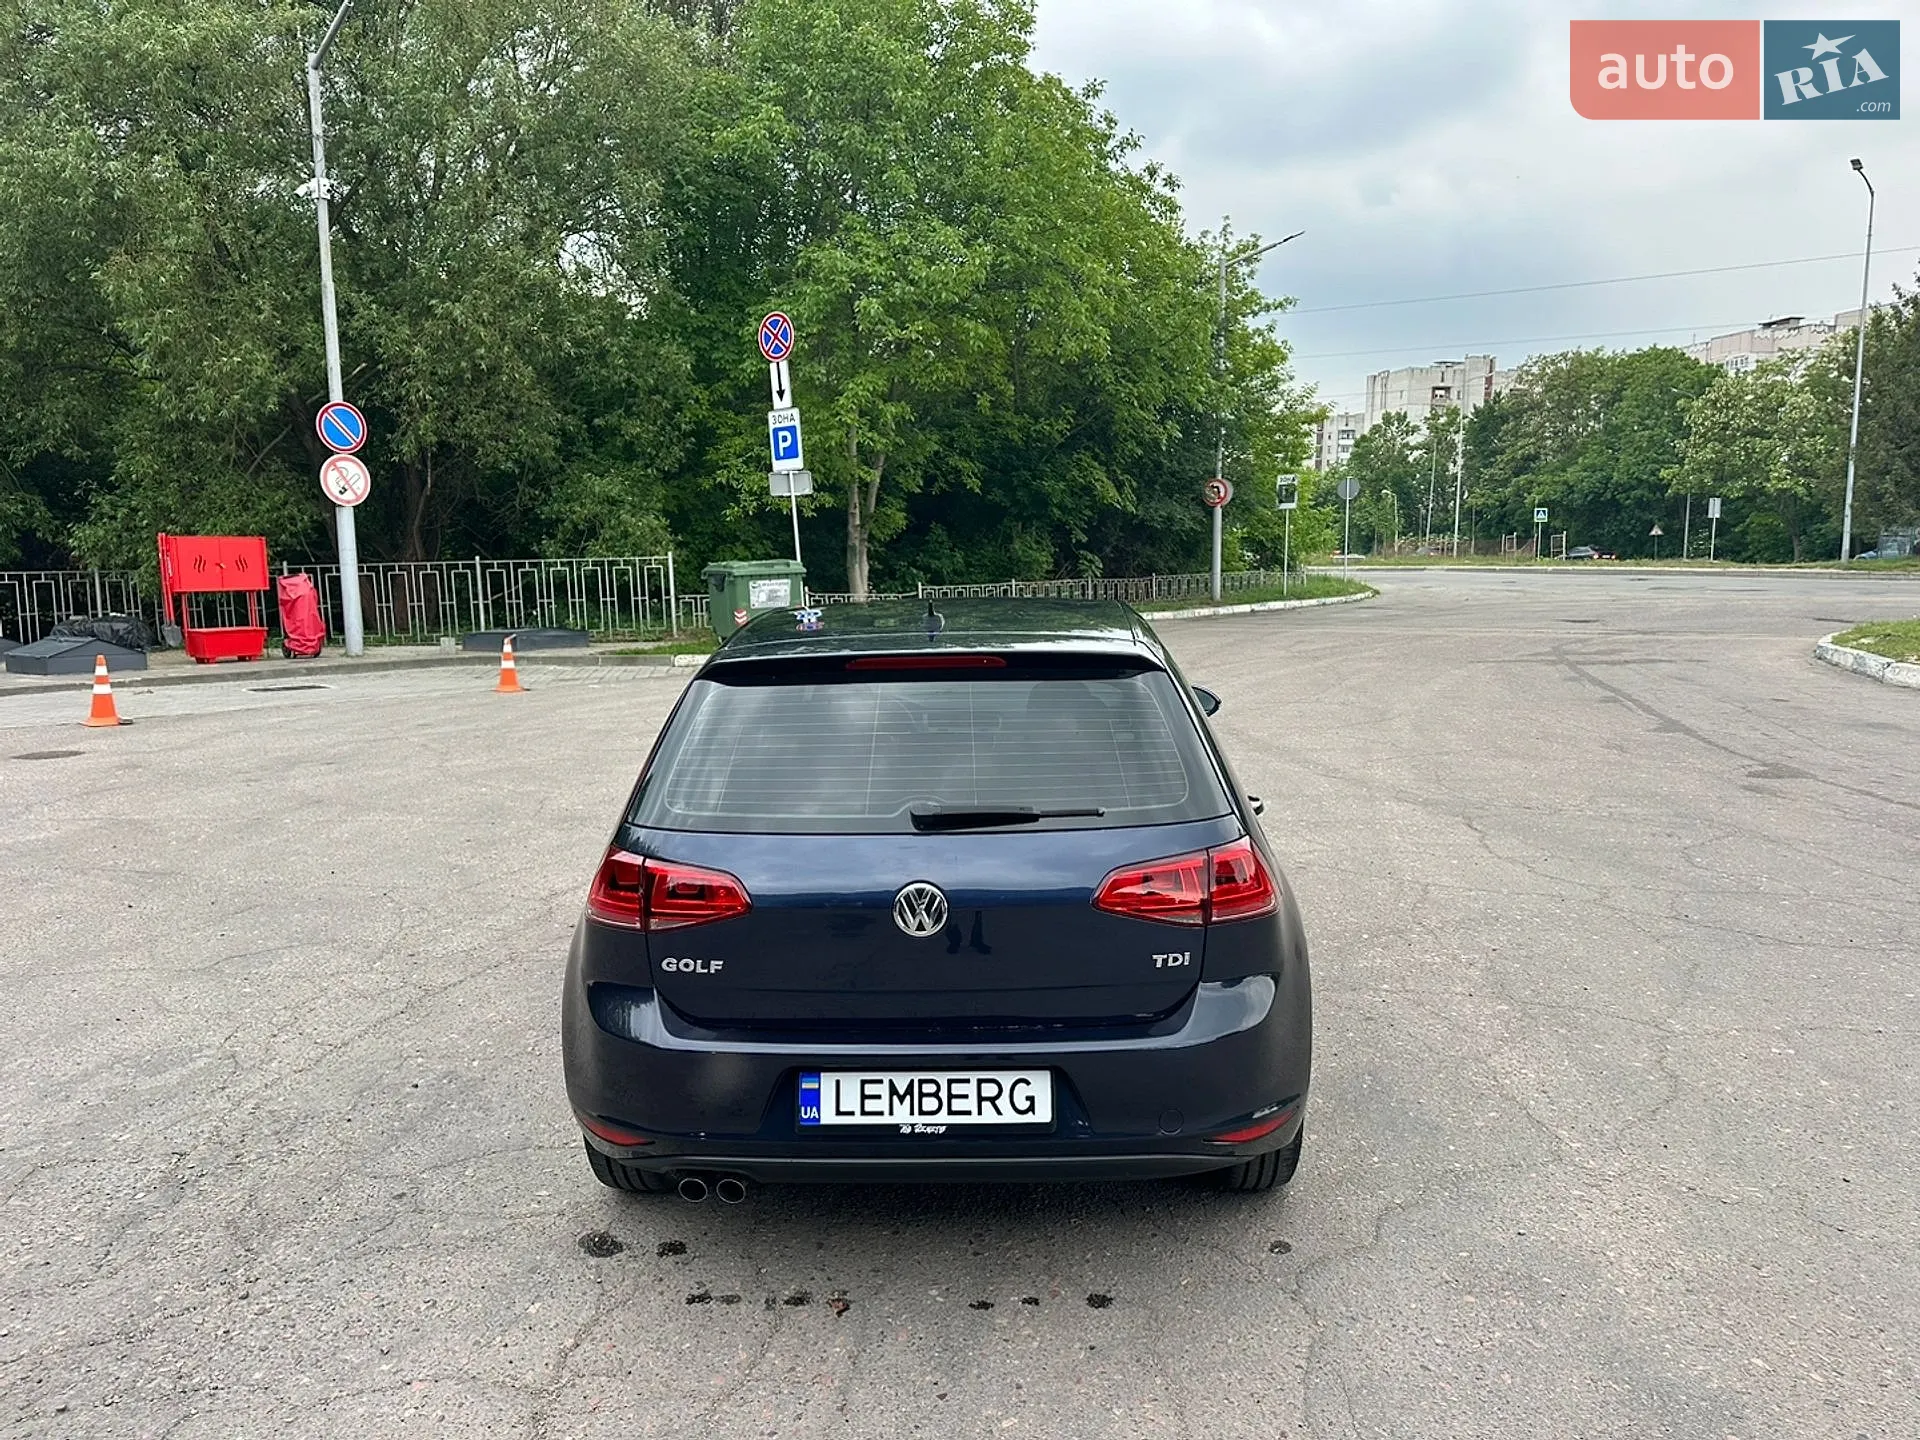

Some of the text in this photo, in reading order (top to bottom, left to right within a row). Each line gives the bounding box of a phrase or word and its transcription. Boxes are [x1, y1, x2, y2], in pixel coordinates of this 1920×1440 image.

[772, 413, 795, 425] ЗОНА
[778, 430, 792, 457] P
[661, 957, 724, 974] GOLF
[835, 1077, 1036, 1117] LEMBERG
[801, 1106, 819, 1119] UA
